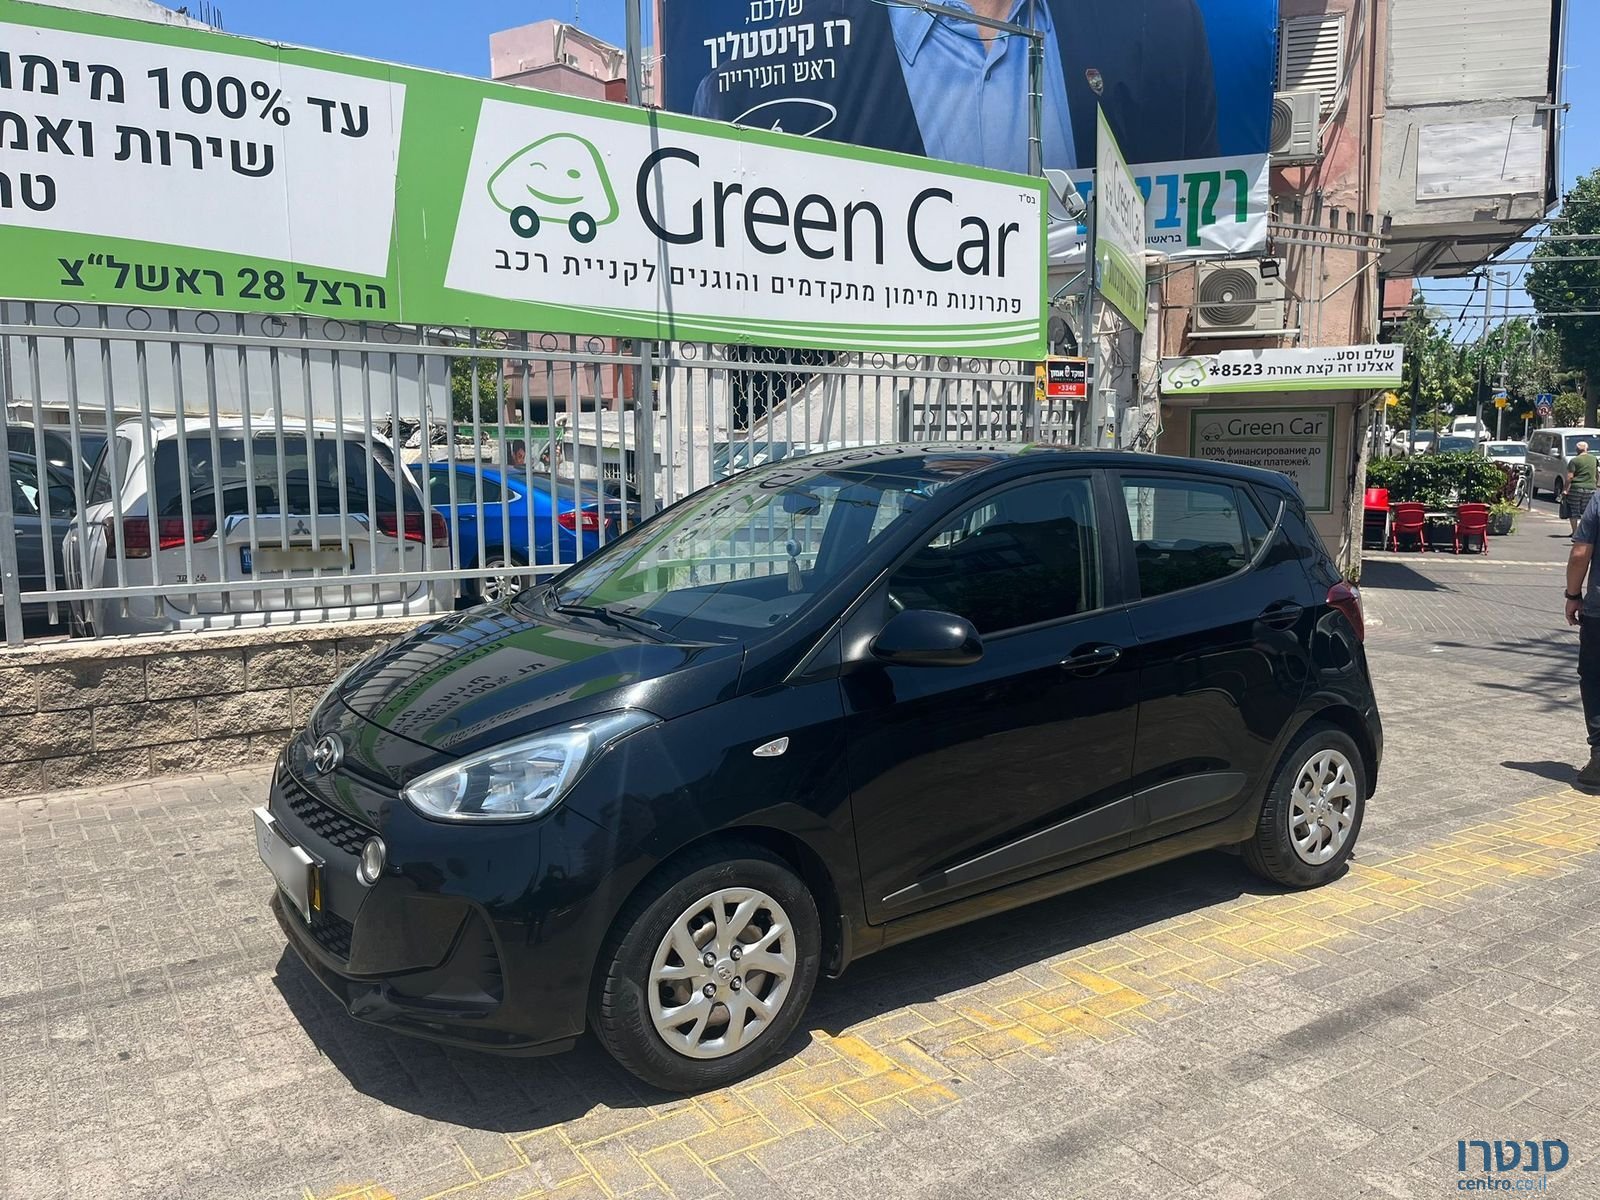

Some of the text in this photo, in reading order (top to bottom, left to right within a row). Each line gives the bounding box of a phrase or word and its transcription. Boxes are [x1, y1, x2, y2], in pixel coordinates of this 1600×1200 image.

[744, 0, 803, 24] שלכם,
[704, 19, 851, 69] רז קינסטליך
[718, 58, 836, 93] ראש העירייה
[147, 67, 291, 127] 100%
[307, 95, 369, 138] עד
[114, 124, 275, 178] שירות
[636, 146, 884, 266] Green
[907, 187, 1020, 278] Car
[238, 267, 286, 301] 28
[296, 271, 387, 309] הרצל
[495, 249, 1022, 314] פתרונות מימון מתקדמים והוגנים לקניית רכב
[1267, 365, 1302, 376] אחרת
[1306, 364, 1333, 376] קצת
[1337, 363, 1351, 374] זה
[1356, 360, 1394, 373] אצלנו
[1364, 348, 1395, 360] שלם
[1227, 417, 1323, 436] Green Car
[1201, 446, 1321, 457] 100% финансирование до
